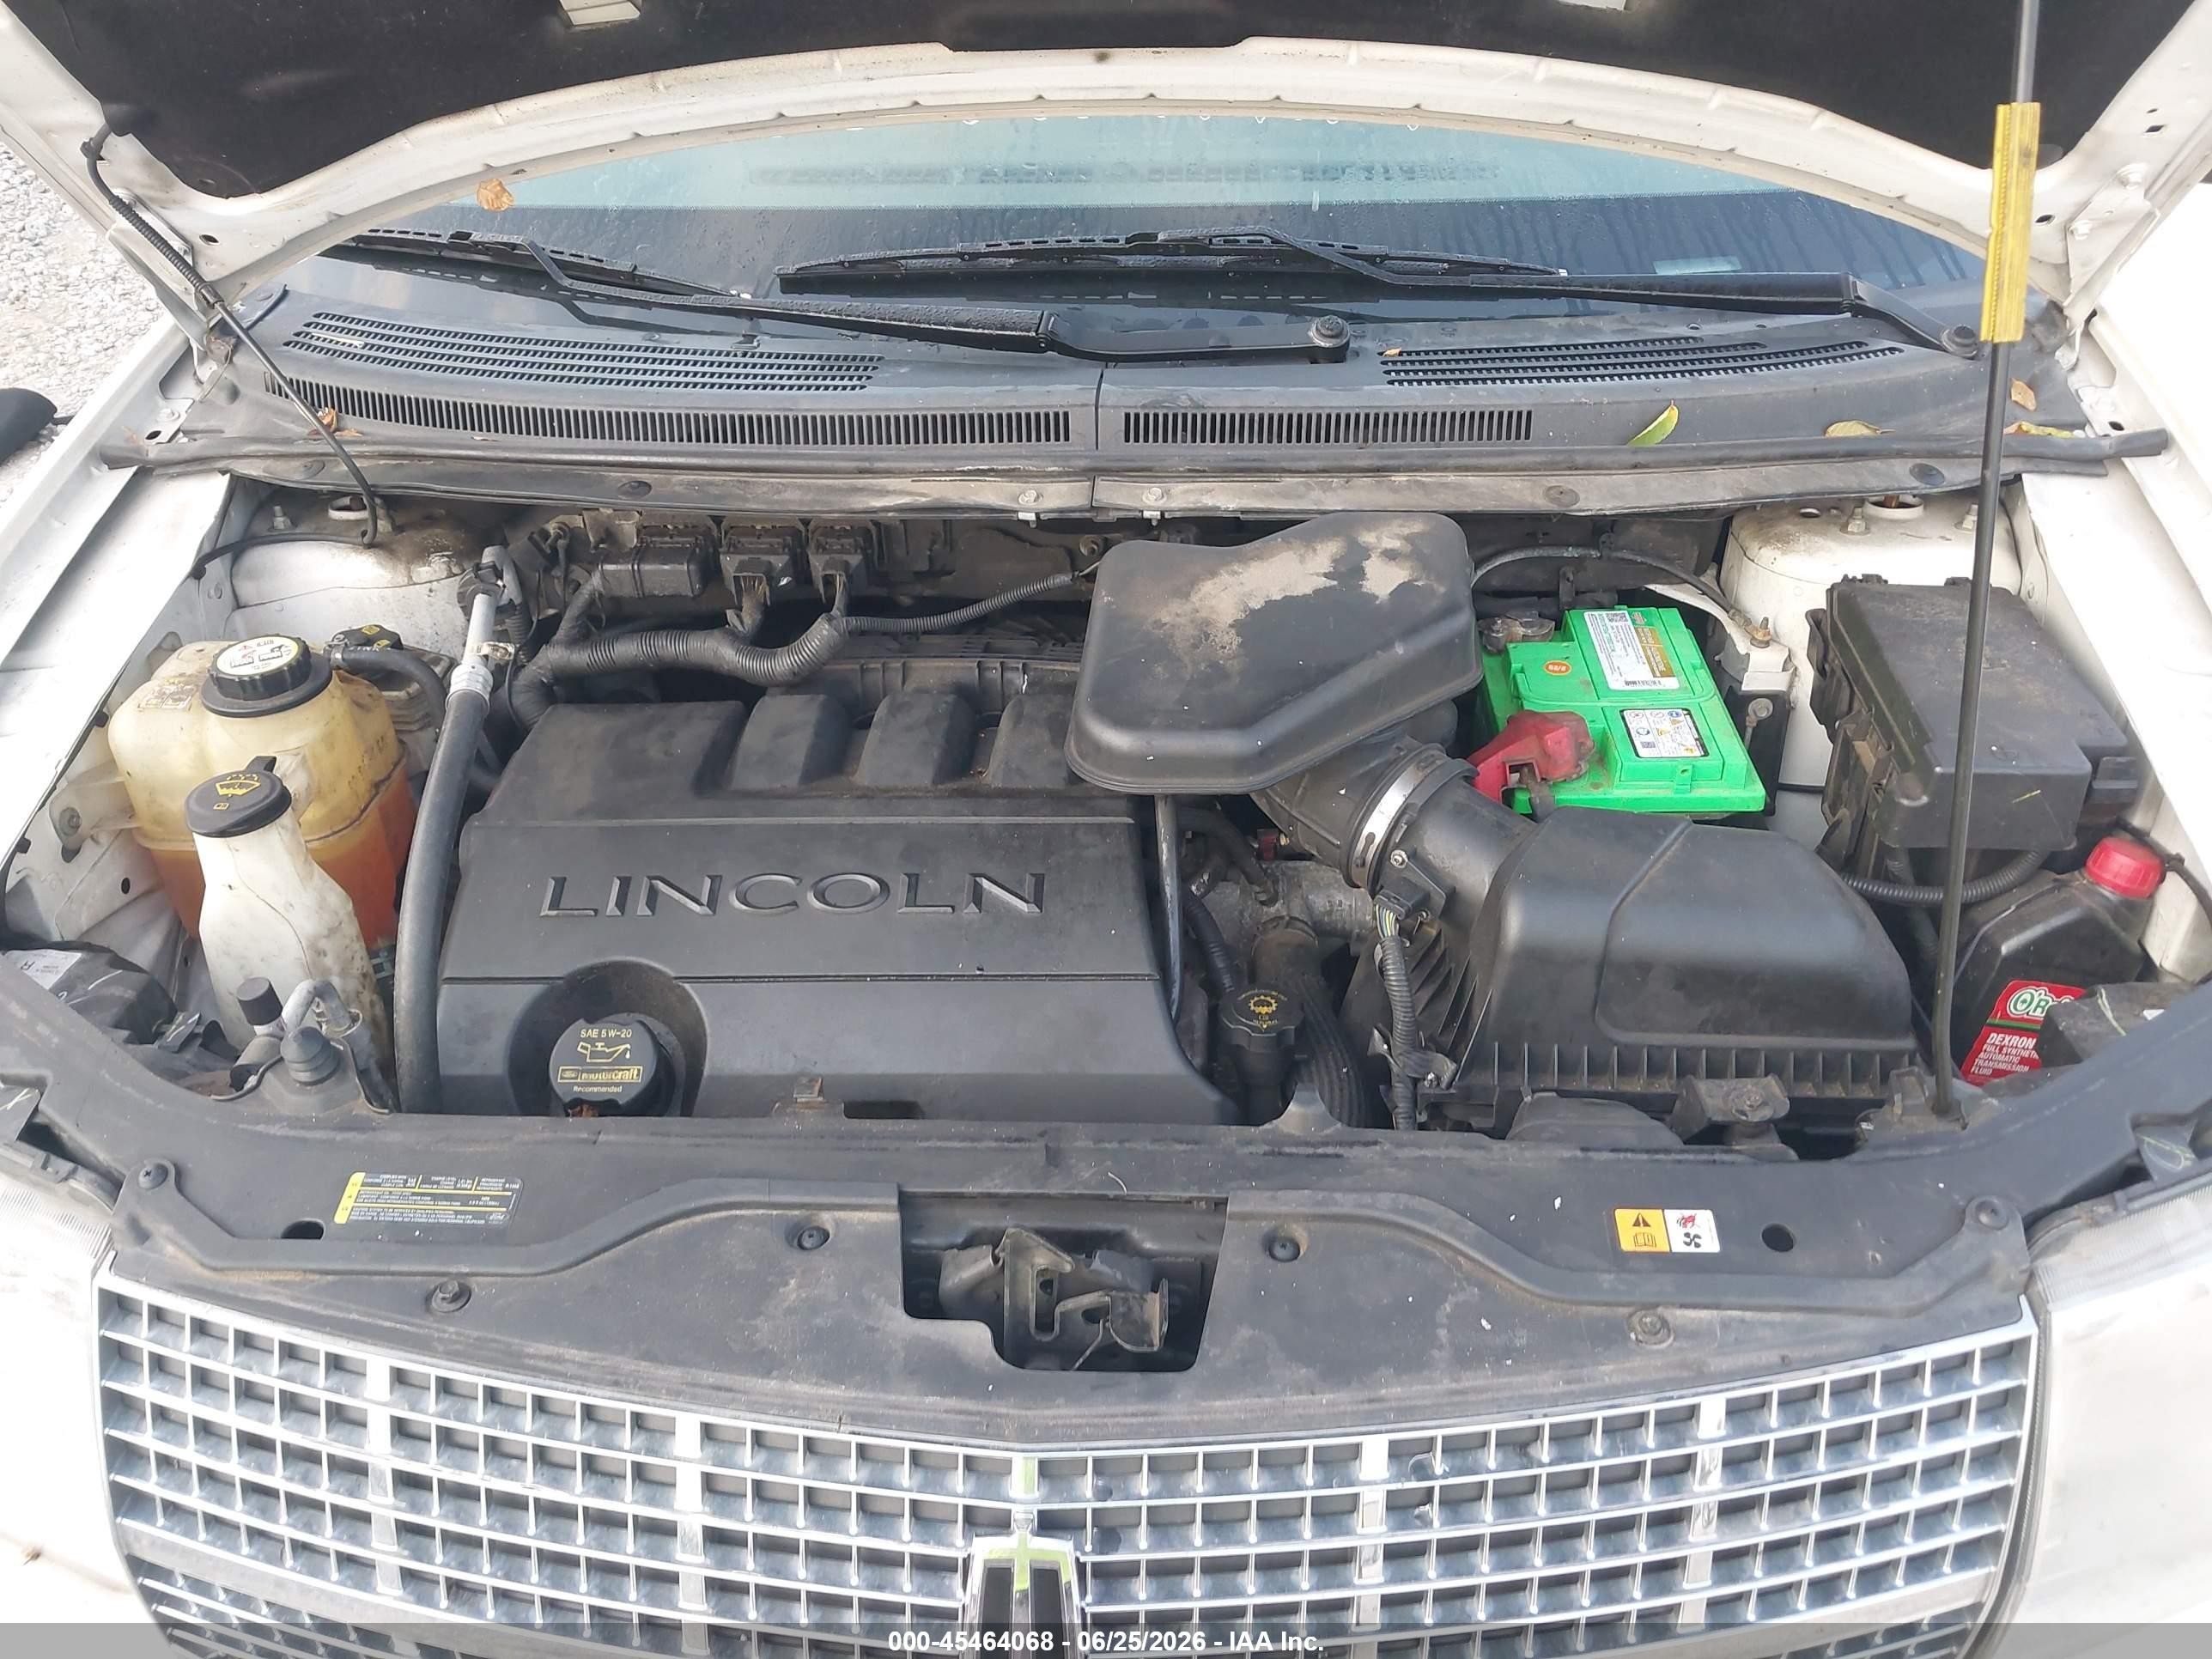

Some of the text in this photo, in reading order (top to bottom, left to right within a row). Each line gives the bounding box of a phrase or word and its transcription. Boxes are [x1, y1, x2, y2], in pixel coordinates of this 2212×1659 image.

[538, 872, 1045, 917] LINCOLN
[580, 1029, 632, 1038] SAE 5W-20
[1986, 1032, 2037, 1048] DEXRON
[1982, 1043, 2000, 1053] FULL
[1978, 1051, 2021, 1063] AUTOMATIC
[1970, 1066, 1993, 1076] FLUID
[1974, 1058, 2030, 1073] TRANSMISSION
[581, 1067, 639, 1080] motorcraft
[573, 1085, 623, 1093] Recommended
